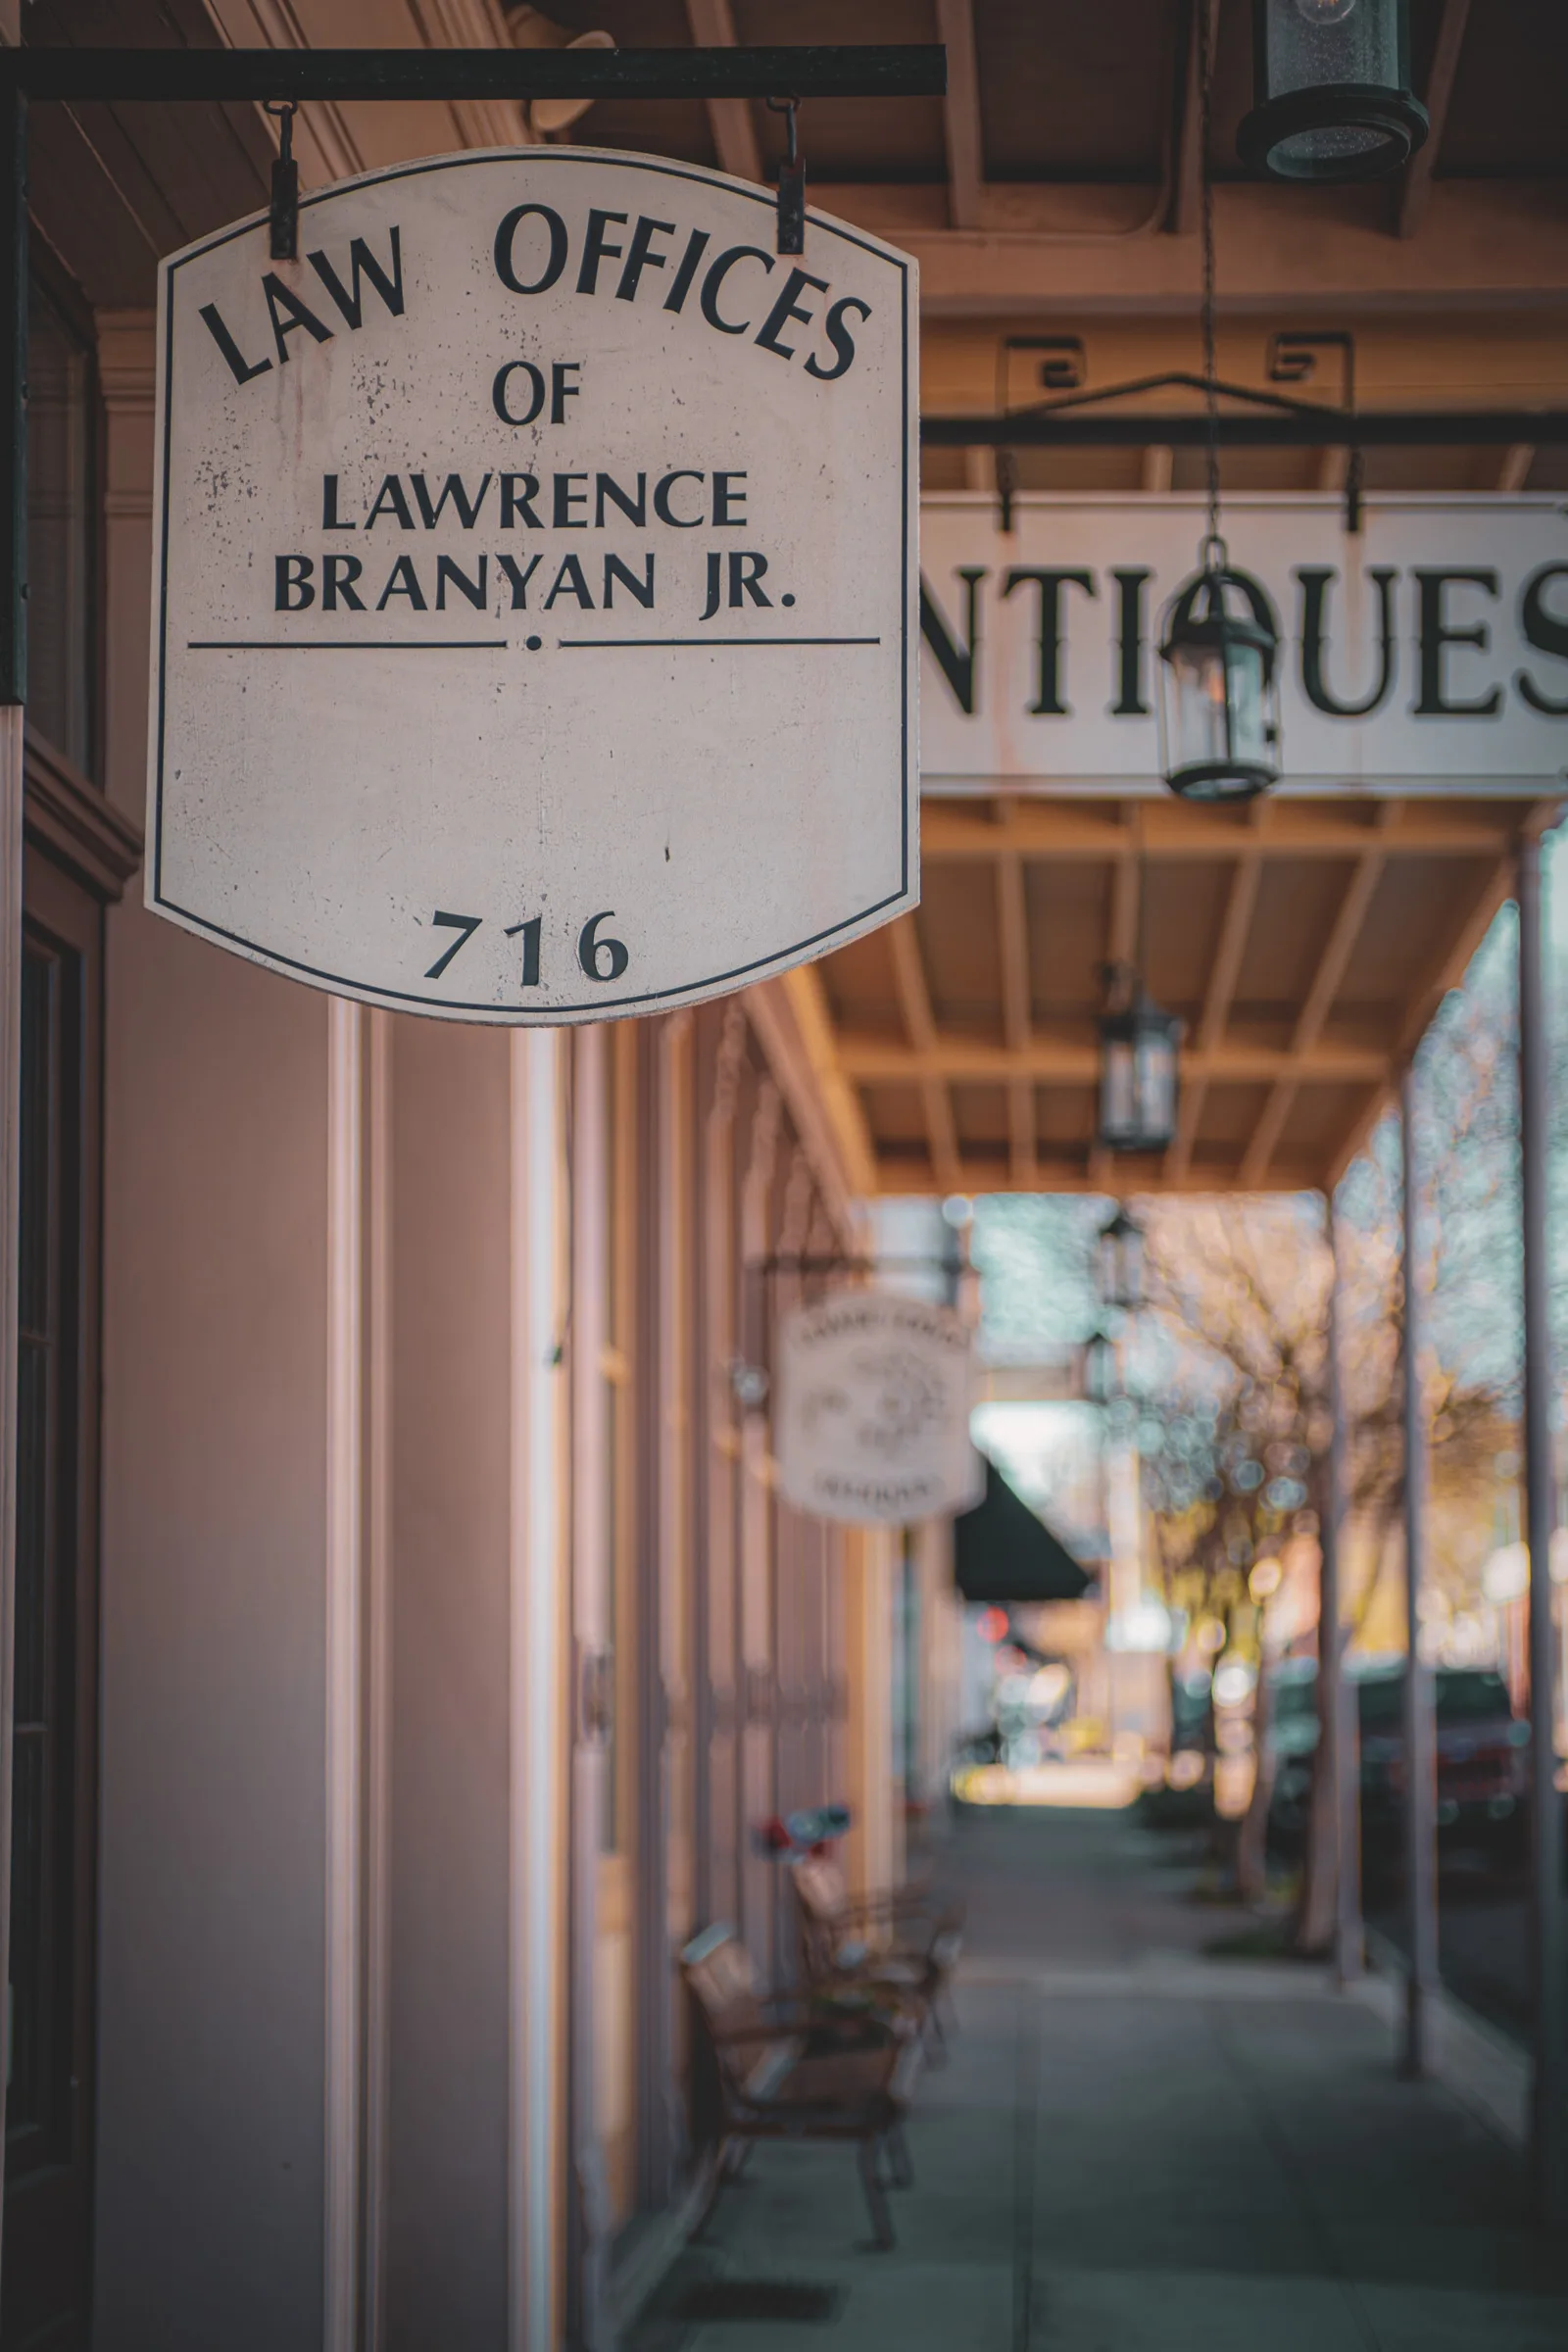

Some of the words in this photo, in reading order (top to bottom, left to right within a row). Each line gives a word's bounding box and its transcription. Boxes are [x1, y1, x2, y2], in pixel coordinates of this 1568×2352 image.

[197, 224, 407, 387] LAW
[492, 202, 873, 381] OFFICES
[491, 360, 582, 427] OF
[320, 469, 749, 530] LAWRENCE
[273, 553, 657, 612] BRANYAN
[697, 551, 797, 622] JR.
[422, 909, 630, 988] 716
